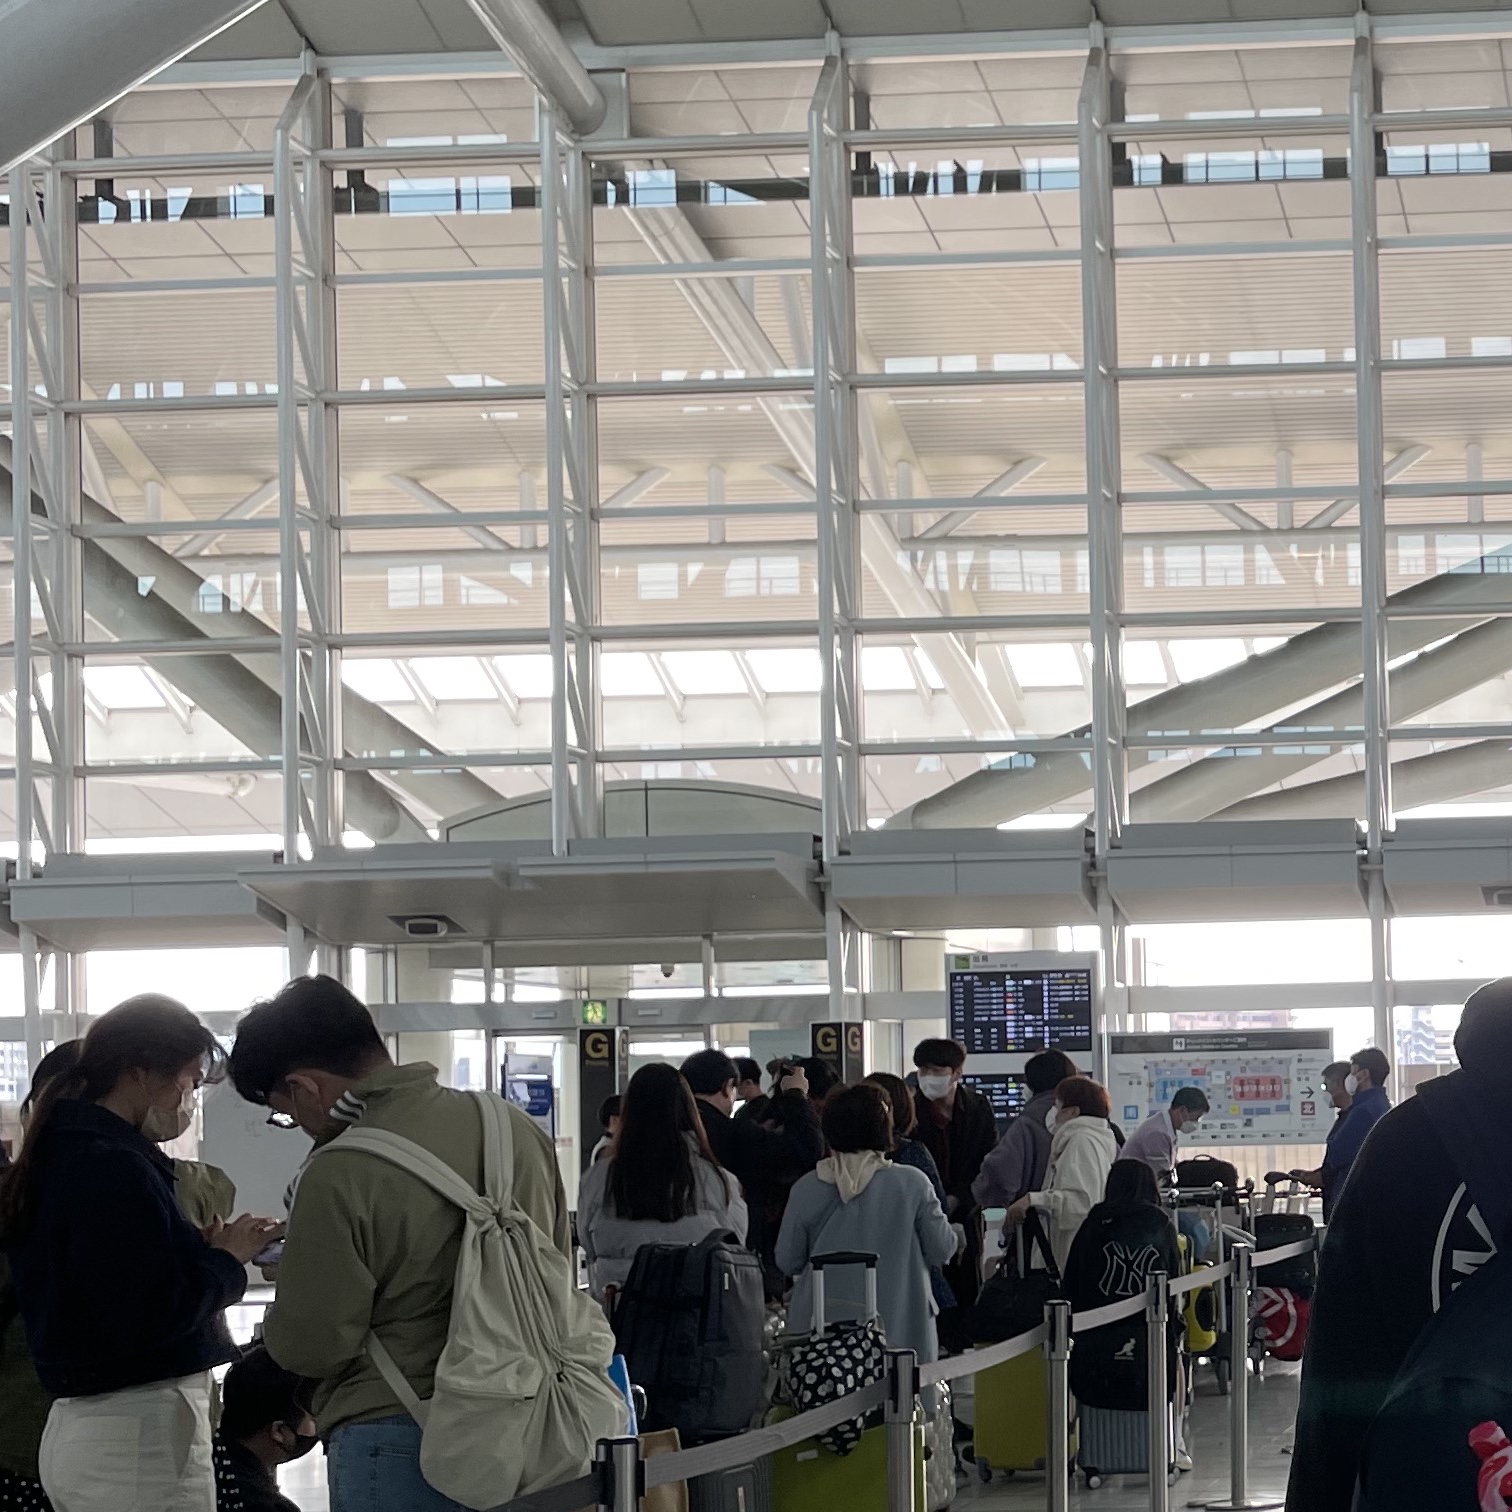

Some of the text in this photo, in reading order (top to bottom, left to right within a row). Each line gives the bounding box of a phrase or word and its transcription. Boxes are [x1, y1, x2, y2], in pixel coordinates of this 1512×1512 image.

[585, 1032, 609, 1059] G
[816, 1026, 837, 1053] G
[847, 1026, 861, 1053] G
[1098, 1240, 1160, 1297] NY
